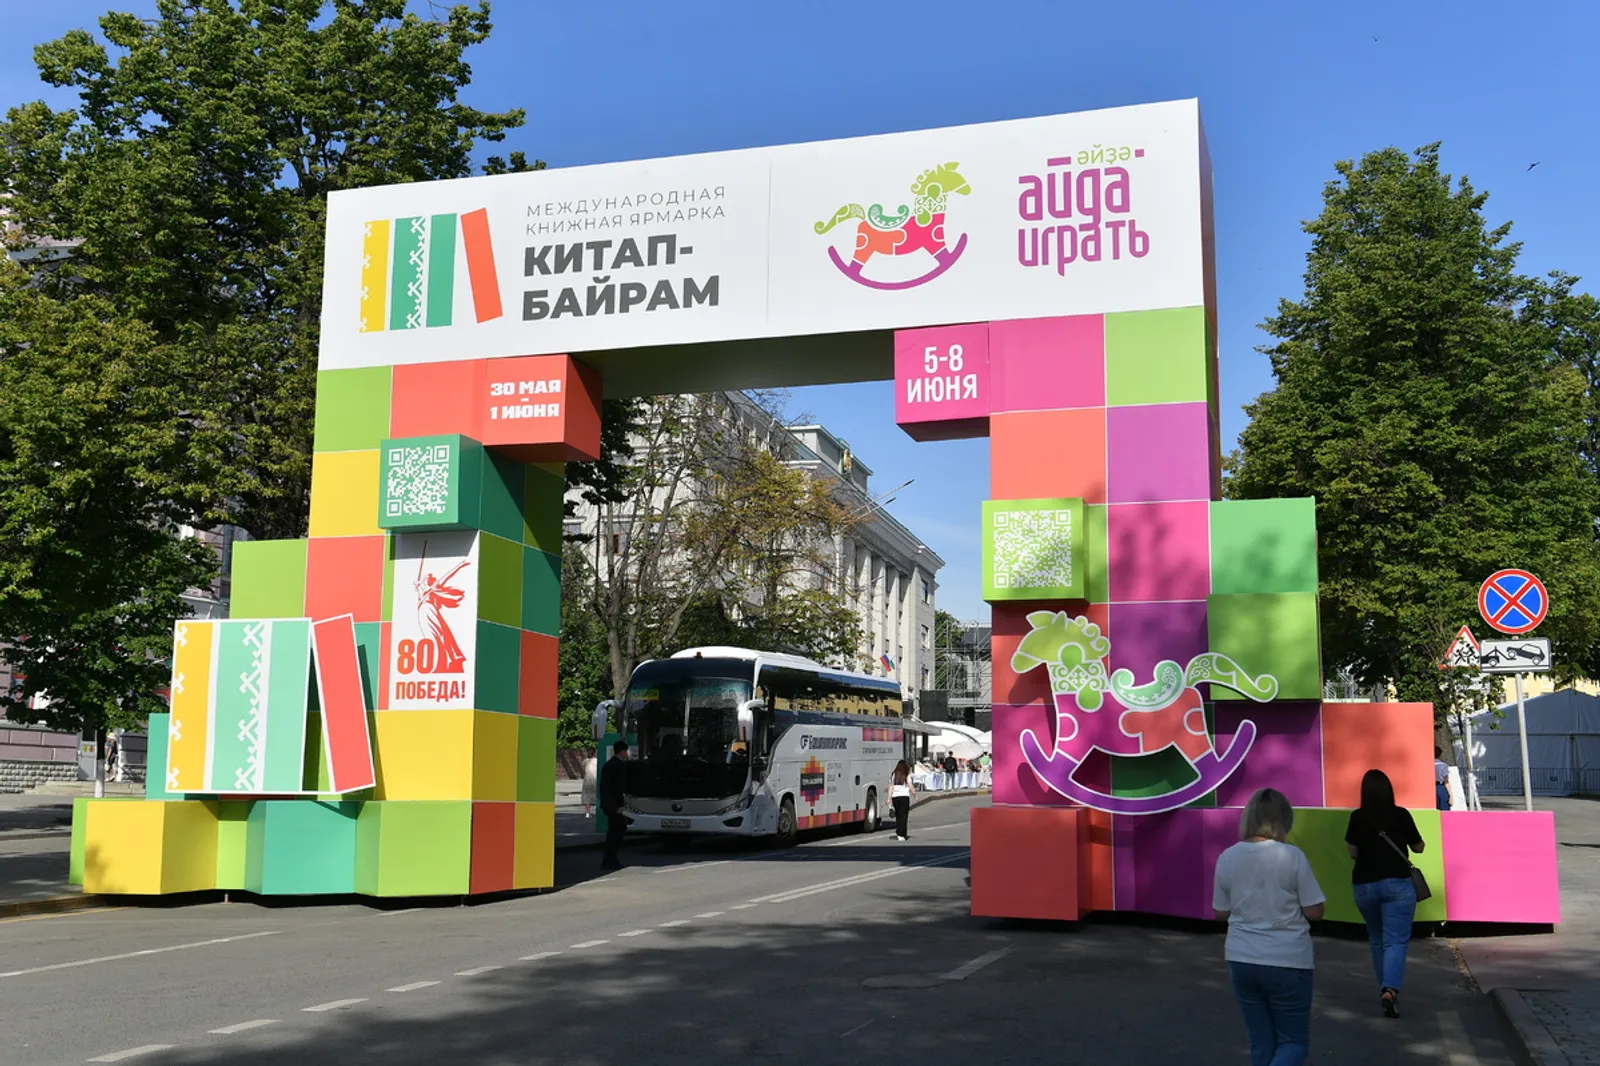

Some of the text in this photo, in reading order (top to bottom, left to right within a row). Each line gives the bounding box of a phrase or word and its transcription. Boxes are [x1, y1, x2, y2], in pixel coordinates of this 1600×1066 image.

[526, 186, 725, 218] МЕЖДУНАРОДНАЯ
[525, 205, 725, 236] КНИЖНАЯ ЯРМАРКА
[524, 233, 693, 277] КИТАП-
[1018, 219, 1150, 277] играть
[522, 275, 720, 321] БАЙРАМ
[924, 344, 964, 374] 5-8
[490, 379, 562, 396] 30 МАЯ
[907, 373, 978, 404] ИЮНЯ
[490, 403, 560, 420] 1 ИЮНЯ
[397, 638, 435, 674] 80
[395, 680, 466, 702] ПОБЕДА!
